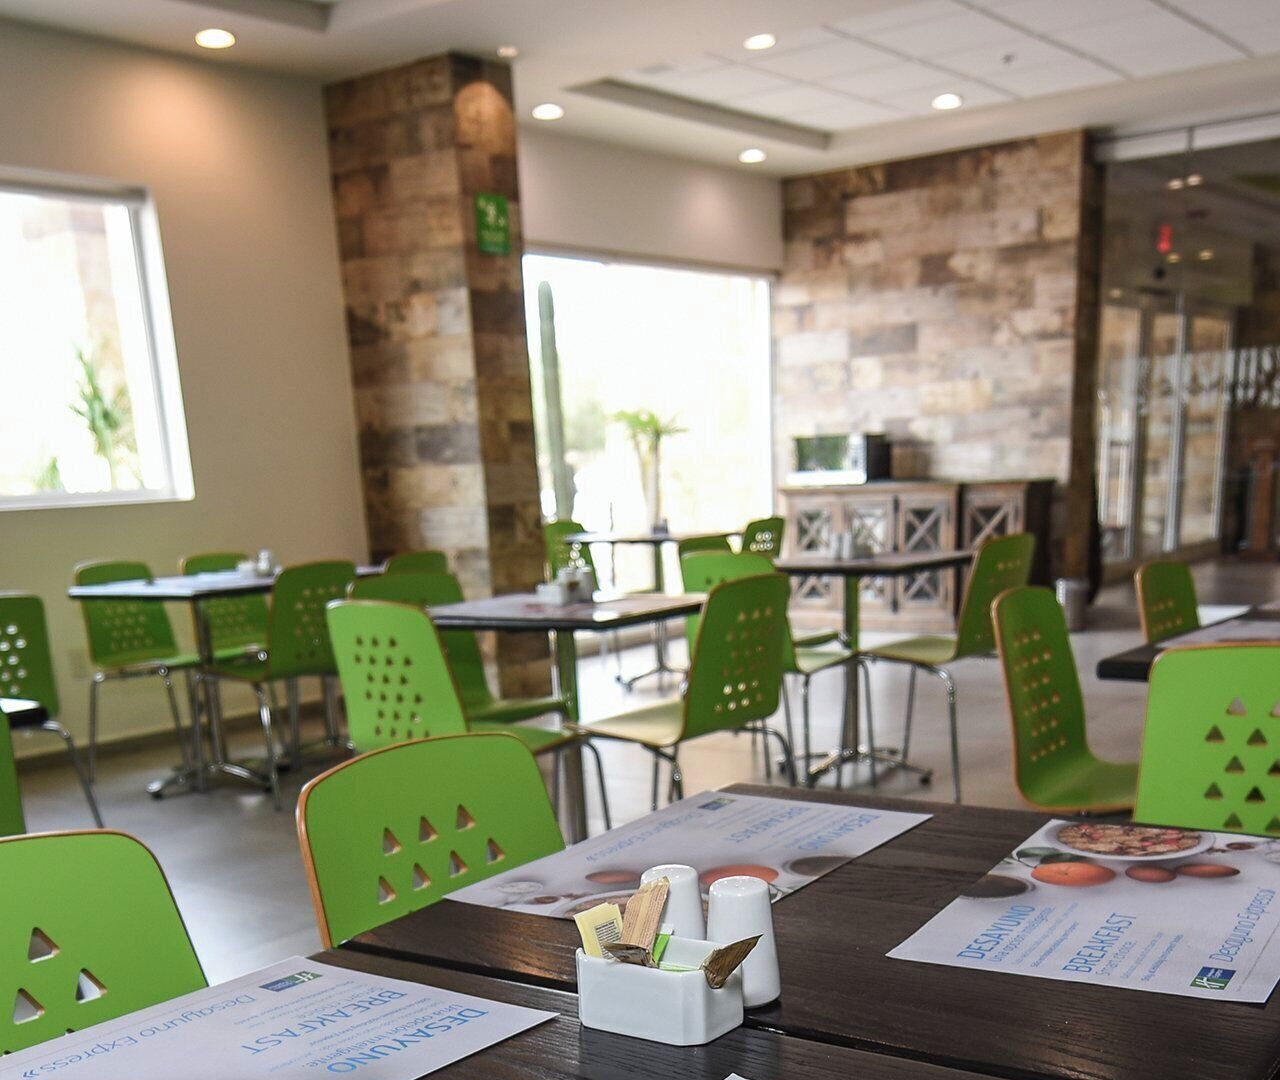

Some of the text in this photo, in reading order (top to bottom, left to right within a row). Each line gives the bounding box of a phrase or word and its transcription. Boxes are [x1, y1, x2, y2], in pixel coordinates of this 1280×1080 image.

[957, 904, 1035, 960] DESAYUNO
[1062, 913, 1136, 973] BREAKFAST
[1208, 921, 1255, 962] Desayuno
[140, 995, 256, 1037] Desayuno
[242, 990, 408, 1054] BREAKFAST
[327, 1008, 488, 1073] DESAYUNO
